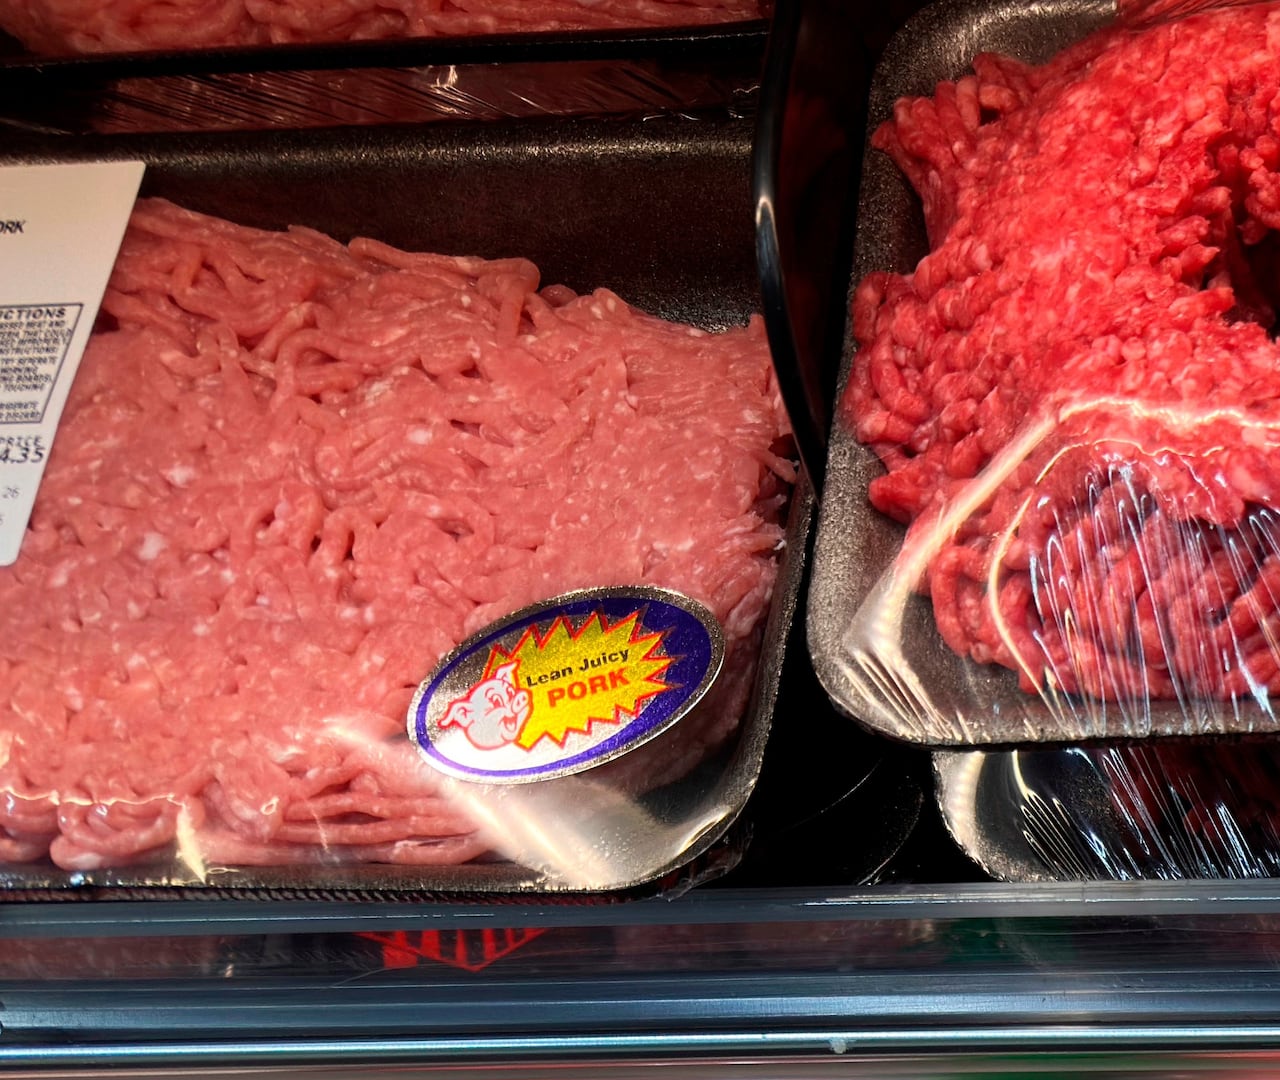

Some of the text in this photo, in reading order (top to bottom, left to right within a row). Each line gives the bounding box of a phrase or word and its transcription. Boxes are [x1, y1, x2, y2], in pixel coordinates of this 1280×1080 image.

[526, 648, 630, 688] Lean Juicy
[546, 667, 630, 708] PORK
